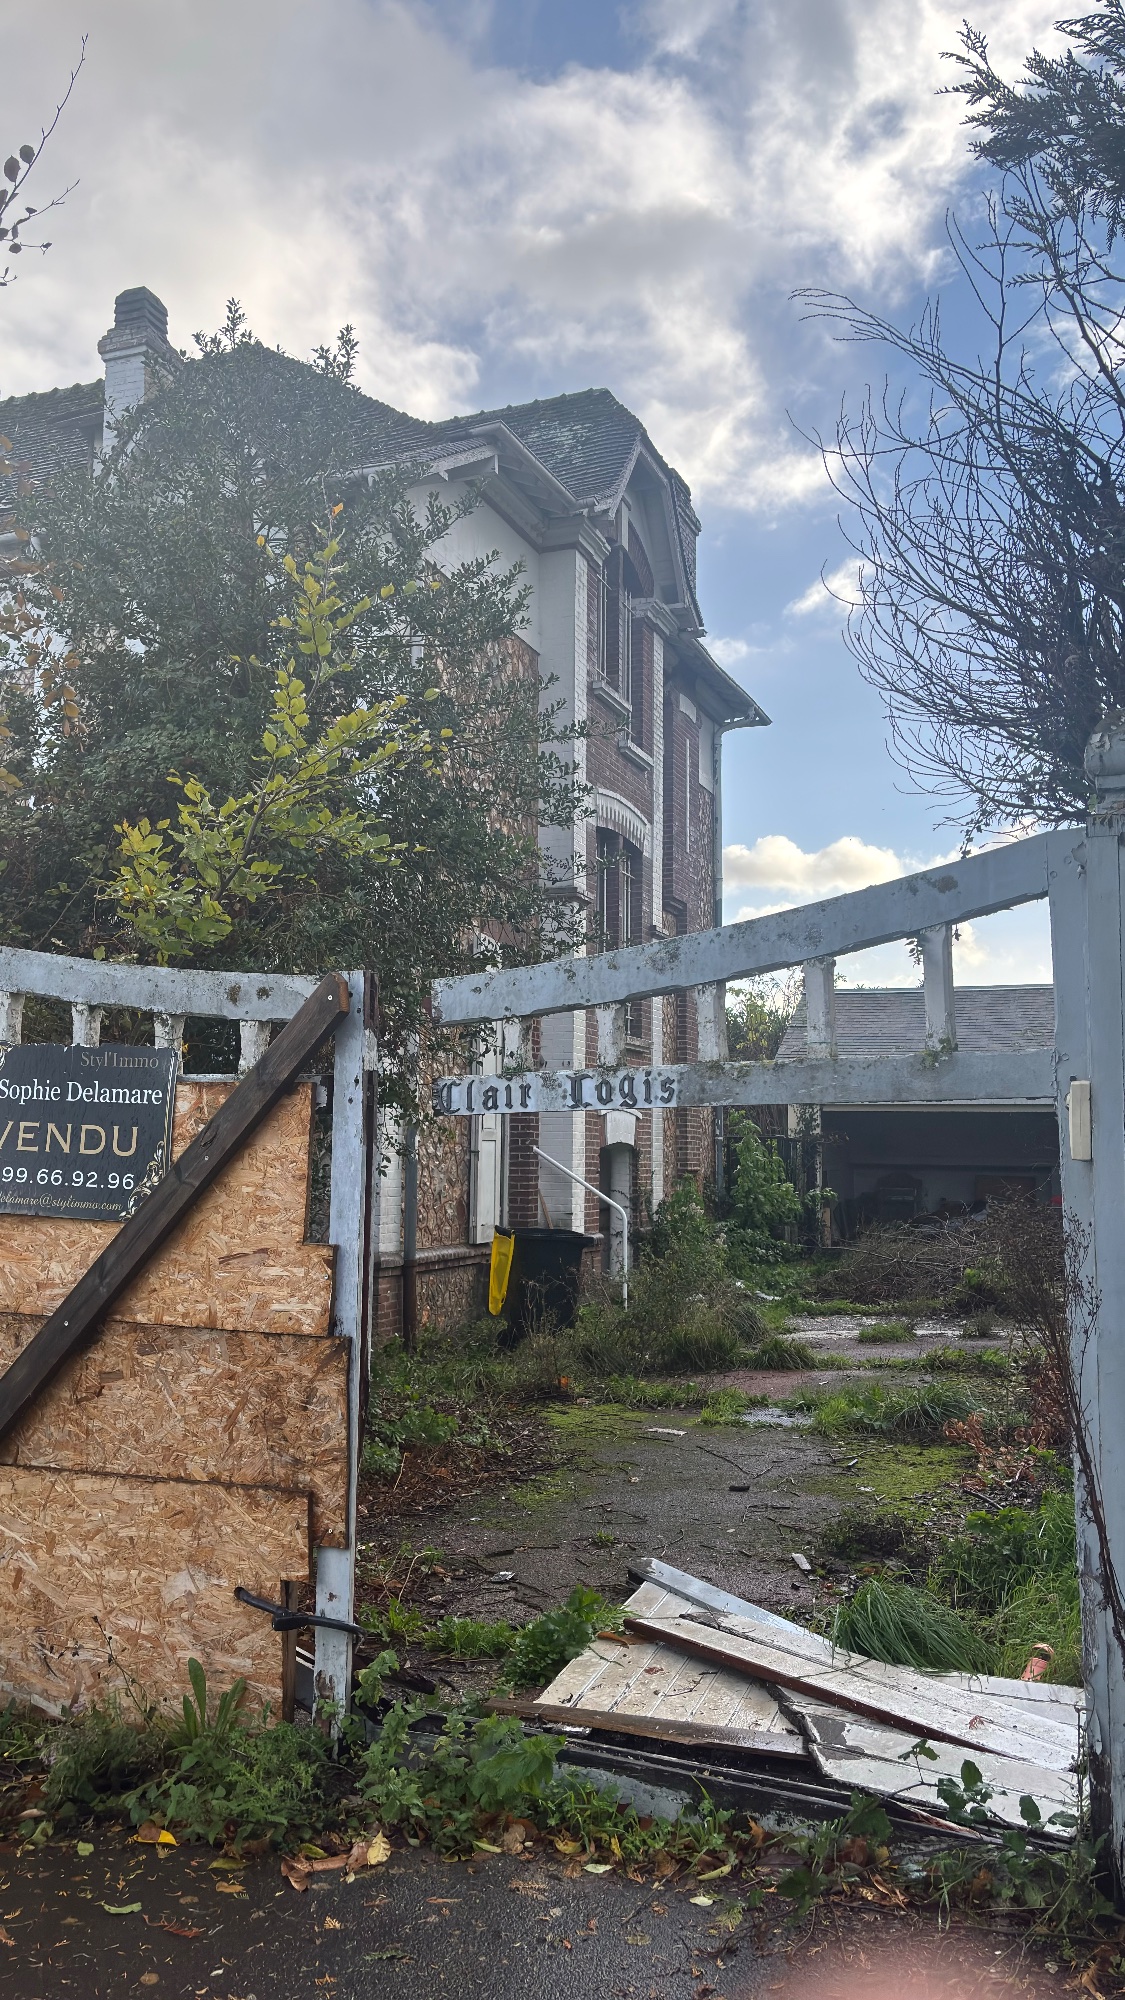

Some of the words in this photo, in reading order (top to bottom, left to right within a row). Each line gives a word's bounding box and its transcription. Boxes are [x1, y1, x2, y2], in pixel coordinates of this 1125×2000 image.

[80, 1051, 159, 1072] Styl'Immo
[0, 1078, 61, 1105] Sophie
[65, 1081, 163, 1105] Delamare
[438, 1076, 533, 1114] Clair
[565, 1073, 676, 1109] Logis
[2, 1166, 135, 1190] 99.66.92.96
